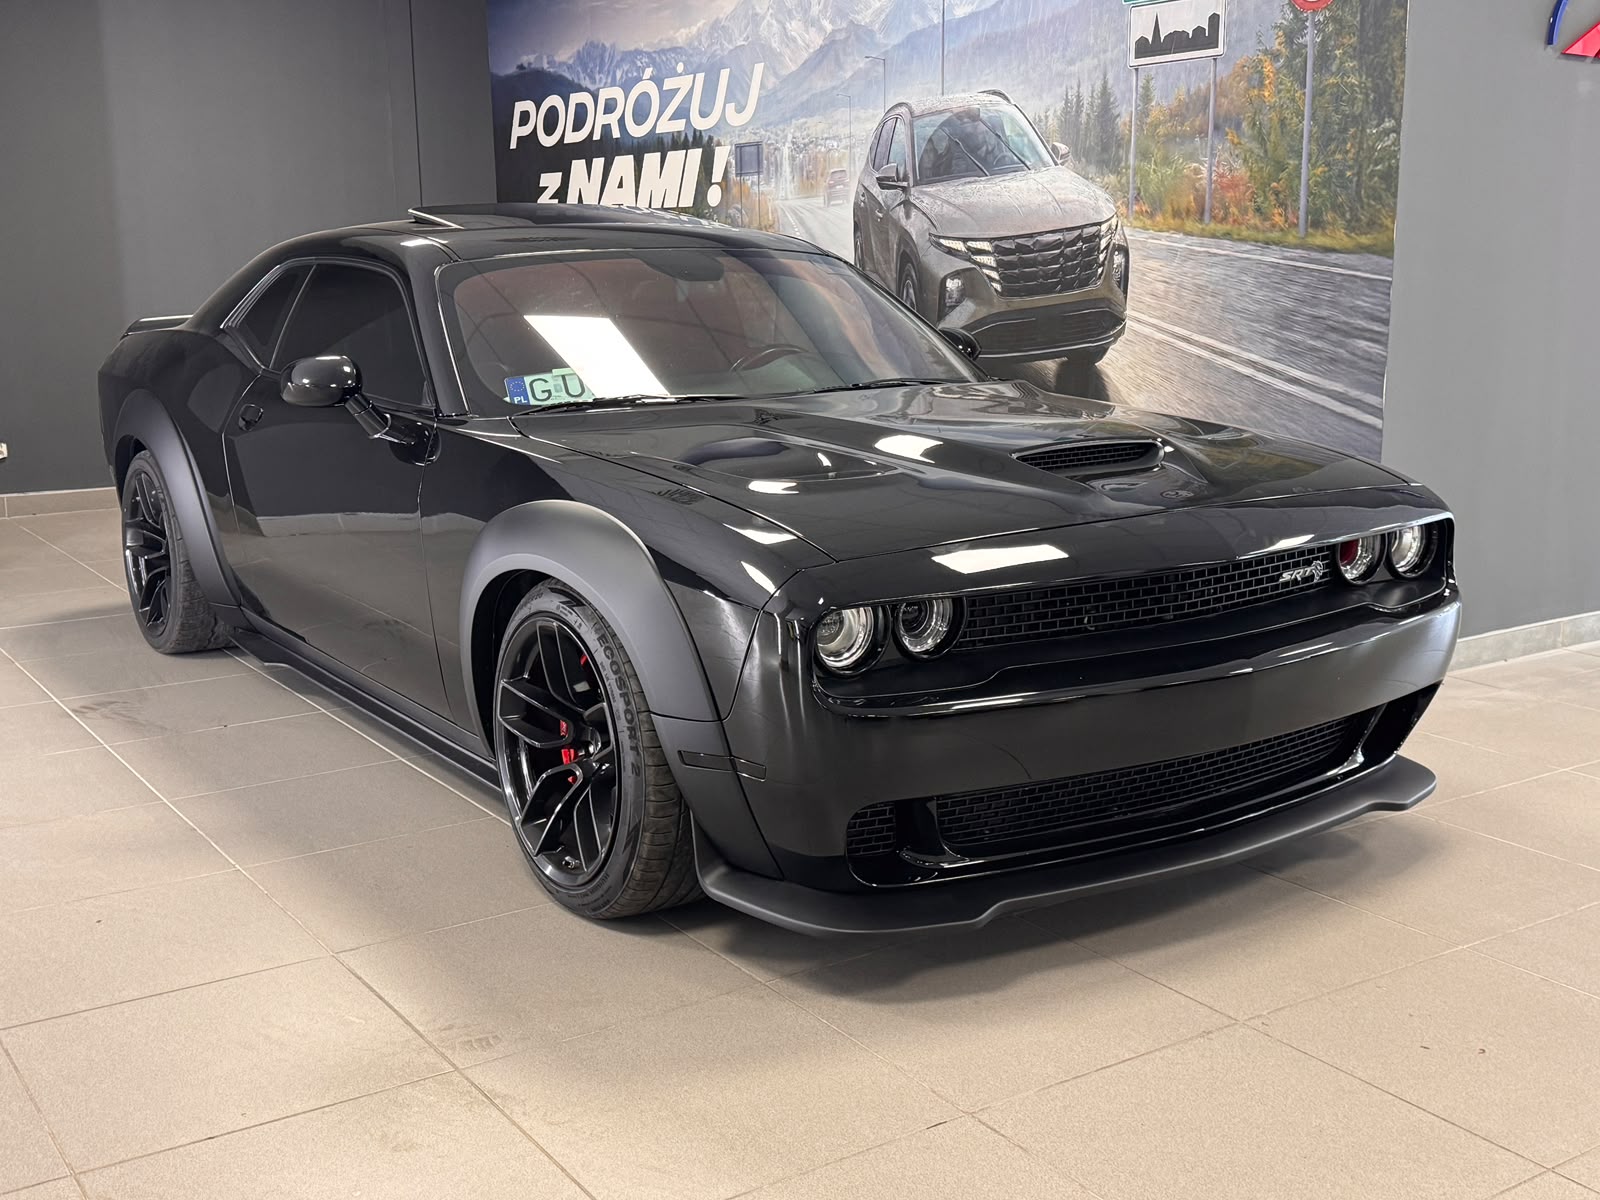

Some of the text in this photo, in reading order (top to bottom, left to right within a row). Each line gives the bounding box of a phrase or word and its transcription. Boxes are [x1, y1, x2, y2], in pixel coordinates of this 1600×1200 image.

[510, 62, 764, 149] PODRÓŻUJ
[514, 396, 527, 404] PL
[1279, 566, 1315, 582] SRT
[597, 634, 640, 757] ECOSPORT
